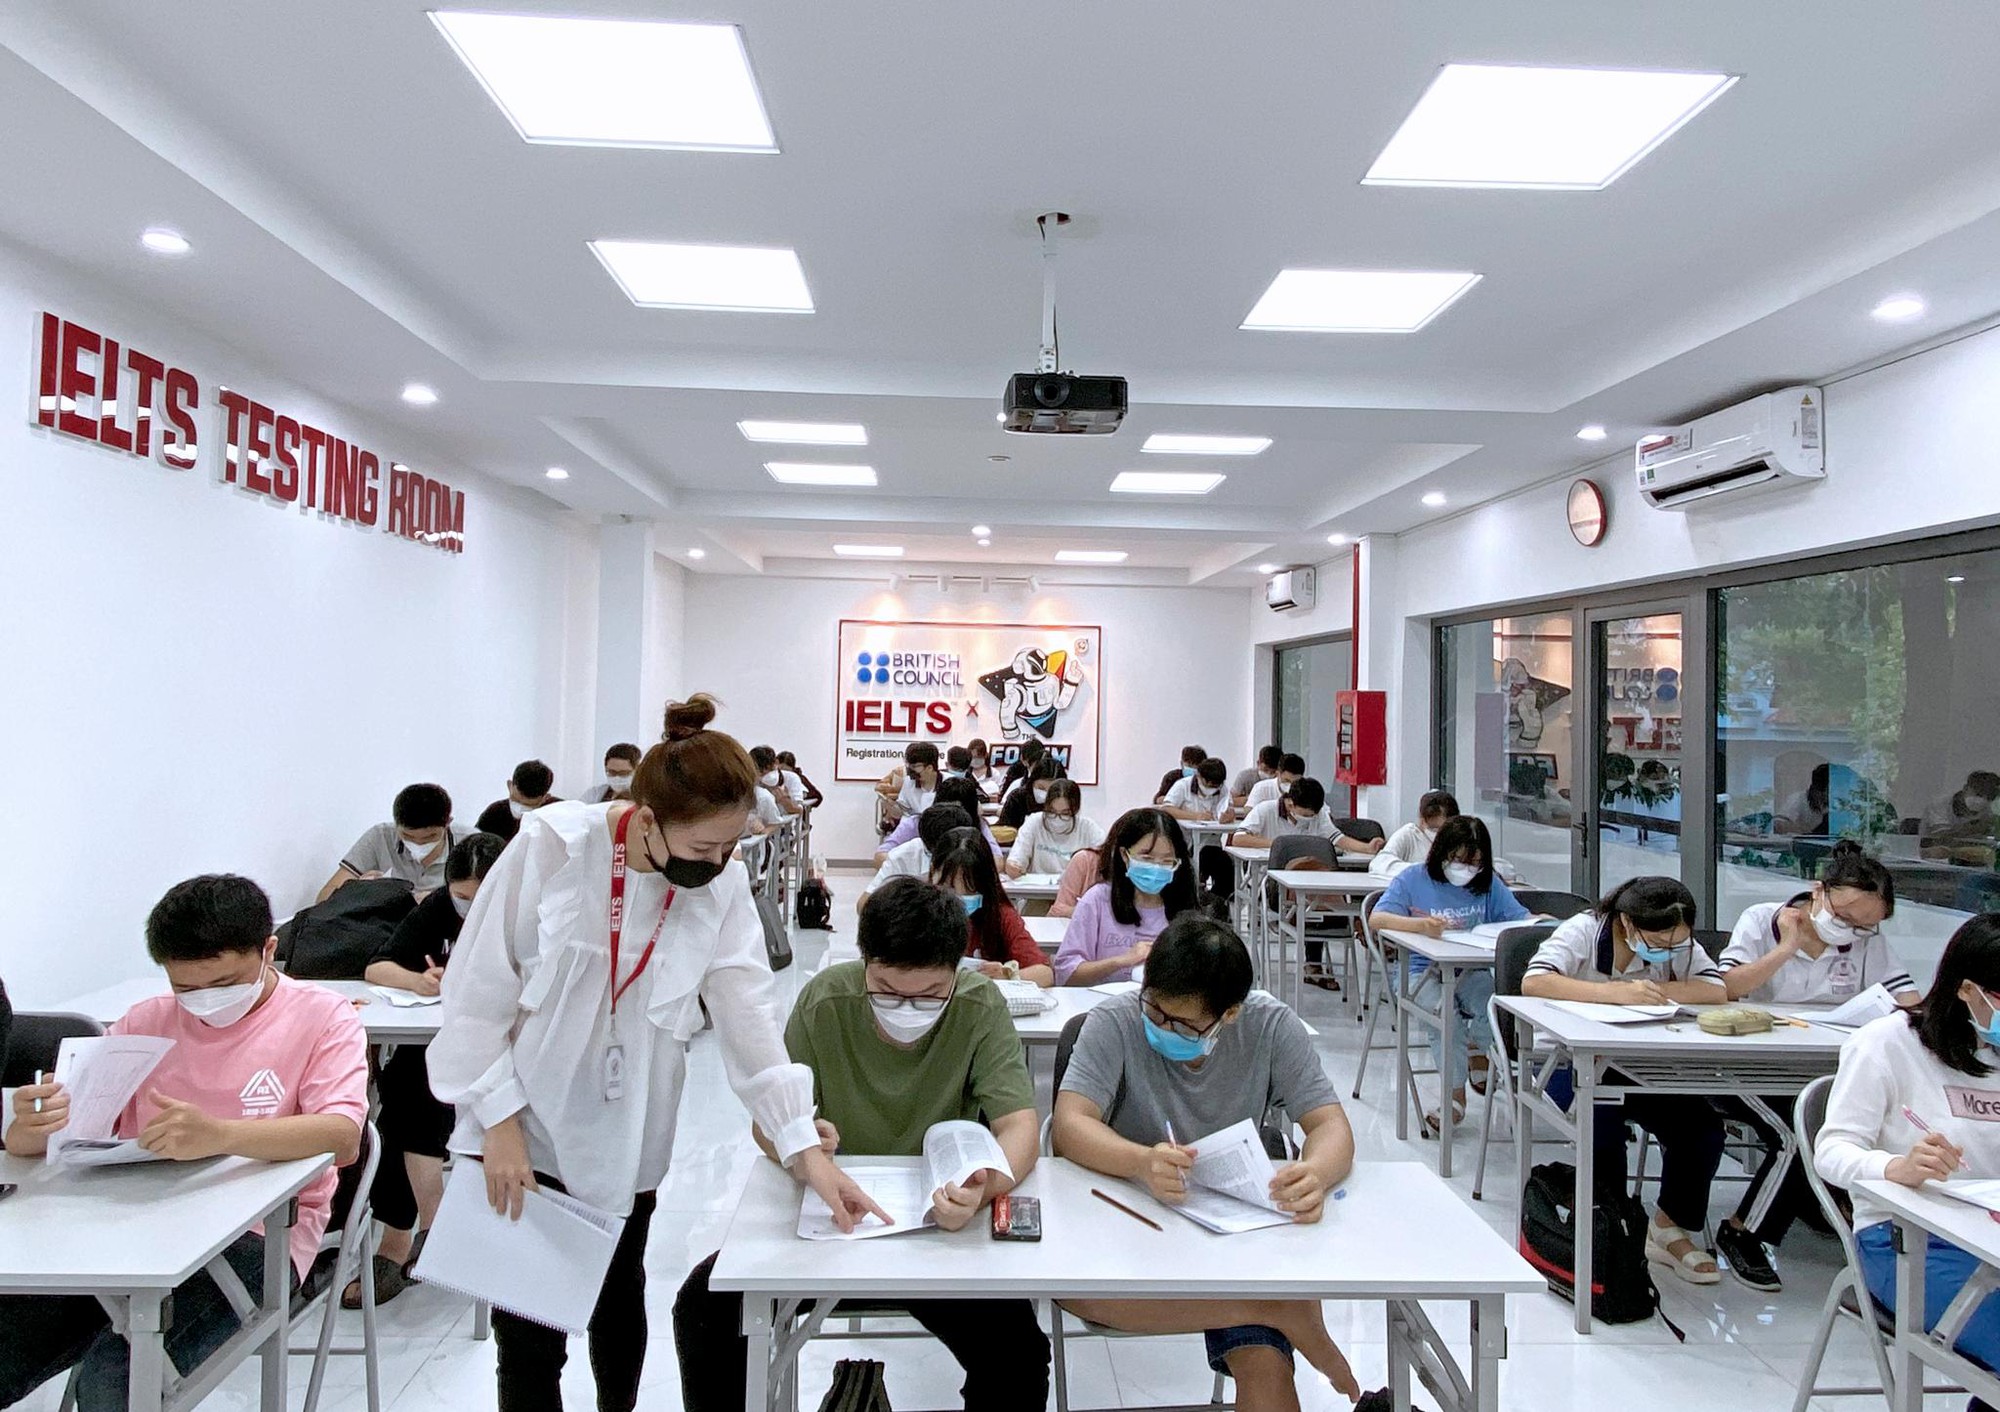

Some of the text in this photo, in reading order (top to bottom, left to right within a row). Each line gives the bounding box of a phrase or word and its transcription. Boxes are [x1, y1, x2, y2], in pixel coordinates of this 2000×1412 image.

[32, 311, 466, 553] IELTS TESTING ROOM
[893, 653, 960, 668] BRITISH
[893, 670, 964, 686] COUNCIL
[845, 700, 953, 734] IELTS
[846, 747, 904, 760] Registration
[613, 843, 626, 878] IELTS
[611, 896, 622, 932] IELTS
[1962, 1093, 2000, 1115] More
